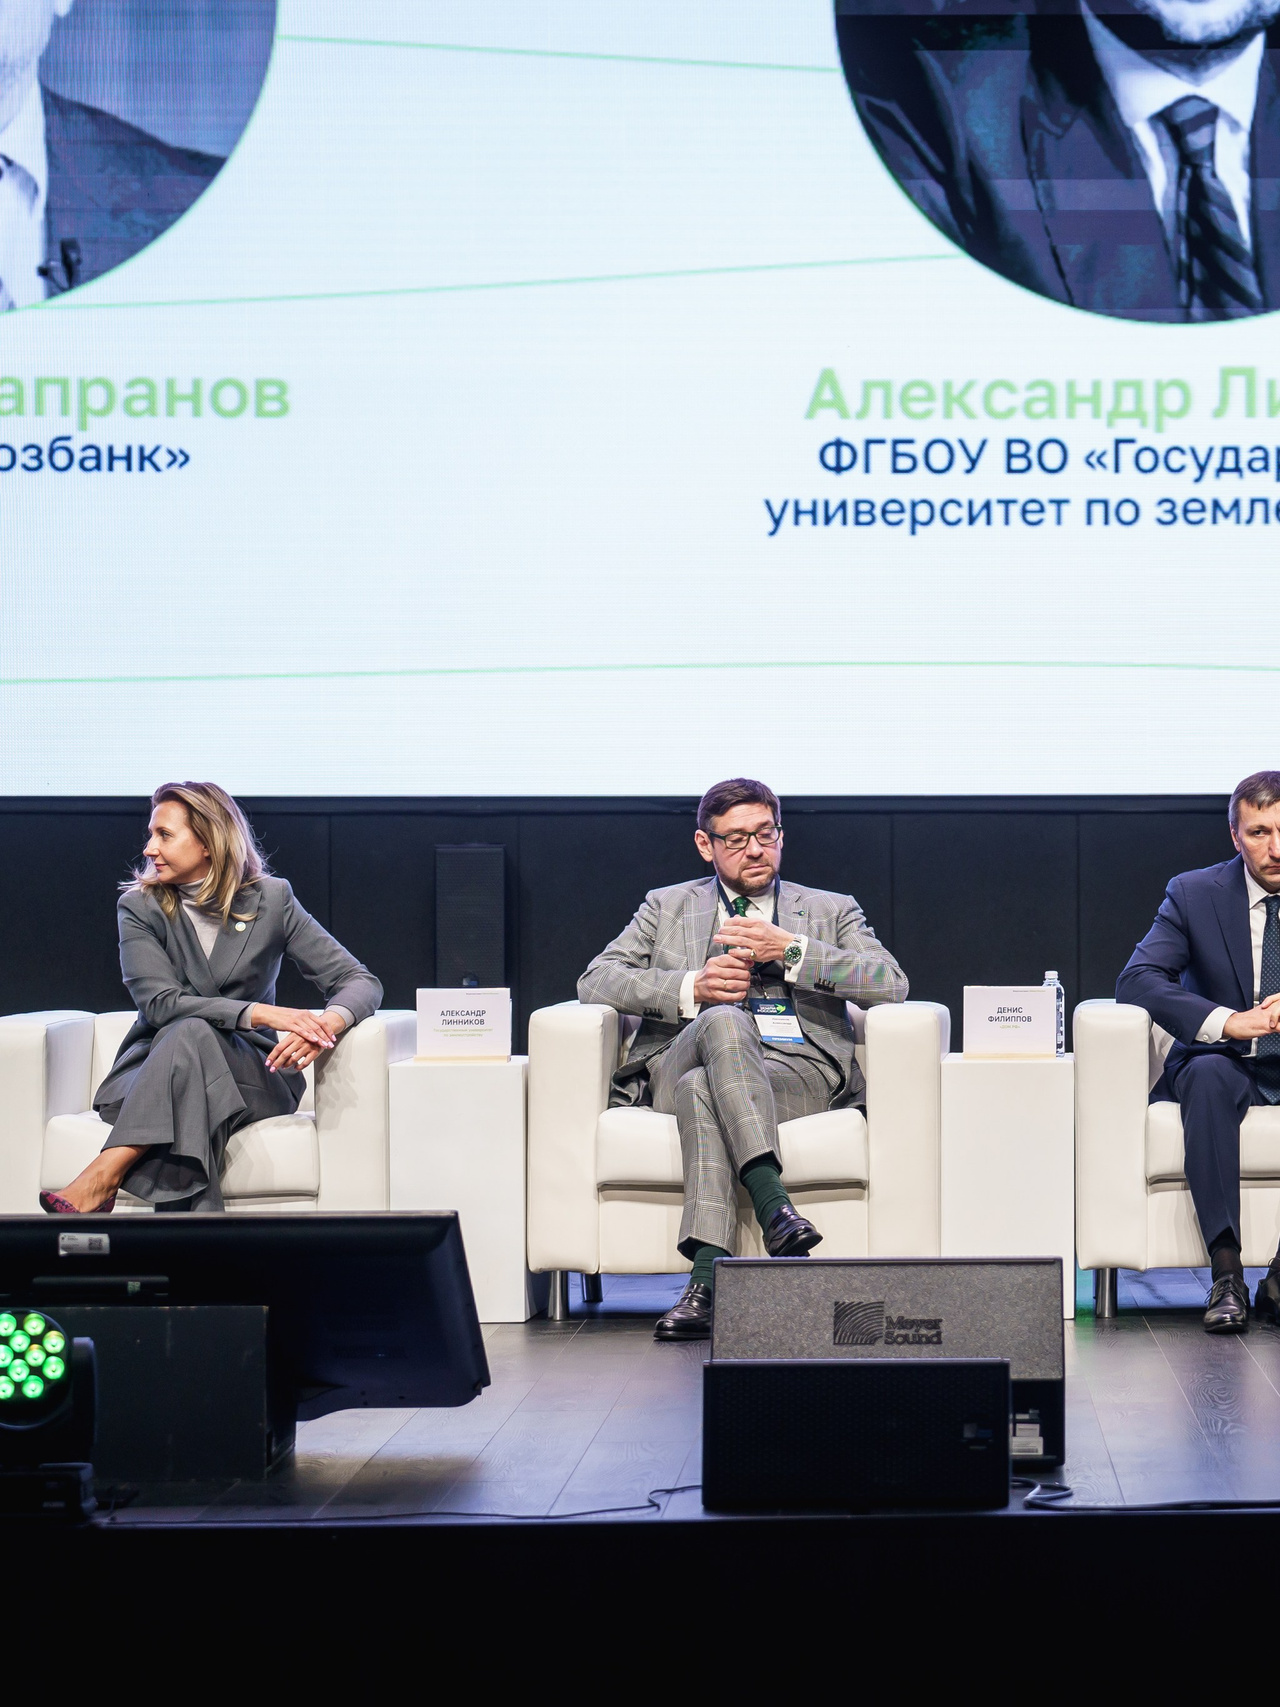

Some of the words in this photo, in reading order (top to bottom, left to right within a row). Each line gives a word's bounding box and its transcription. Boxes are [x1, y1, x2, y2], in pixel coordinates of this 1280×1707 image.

[0, 375, 291, 432] апранов
[805, 367, 1194, 433] Александр
[0, 435, 191, 473] озбанк»
[818, 437, 988, 475] ФГБОУ
[1005, 437, 1069, 475] ВО
[763, 497, 1071, 536] университет
[1085, 497, 1141, 527] по
[440, 1009, 487, 1017] АЛЕКСАНДР
[996, 1006, 1023, 1014] ДЕНИС
[441, 1018, 485, 1026] ЛИННИКОВ
[987, 1015, 1032, 1023] ФИЛИППОВ
[885, 1316, 943, 1332] Meyer
[884, 1331, 943, 1345] Sound
